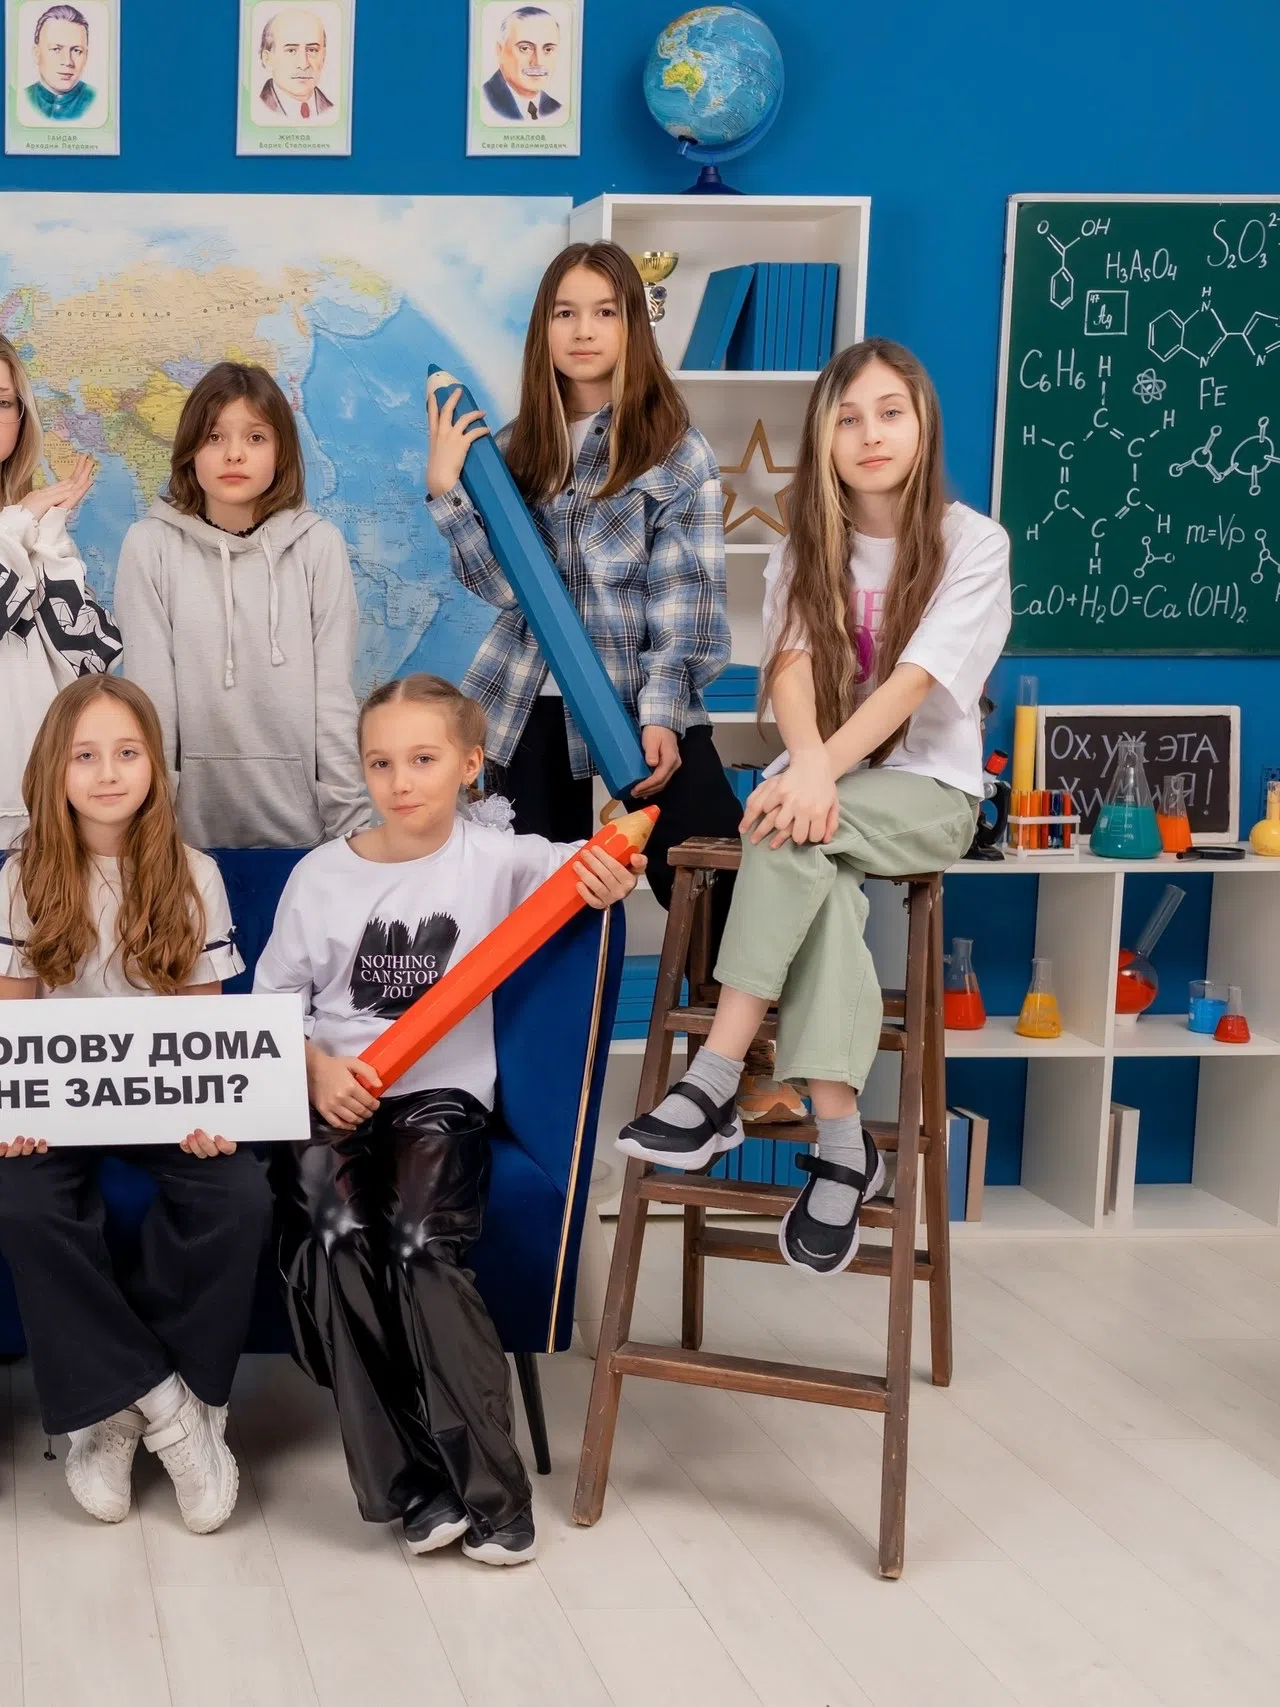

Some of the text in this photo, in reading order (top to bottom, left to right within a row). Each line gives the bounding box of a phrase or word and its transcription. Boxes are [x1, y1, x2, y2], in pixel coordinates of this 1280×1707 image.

[1081, 217, 1111, 236] OH
[360, 955, 436, 969] NOTHING
[361, 970, 438, 984] CAN STOP
[382, 985, 414, 999] YOU
[148, 1030, 282, 1067] ДОМА
[65, 1074, 250, 1107] ЗАБЫЛ?
